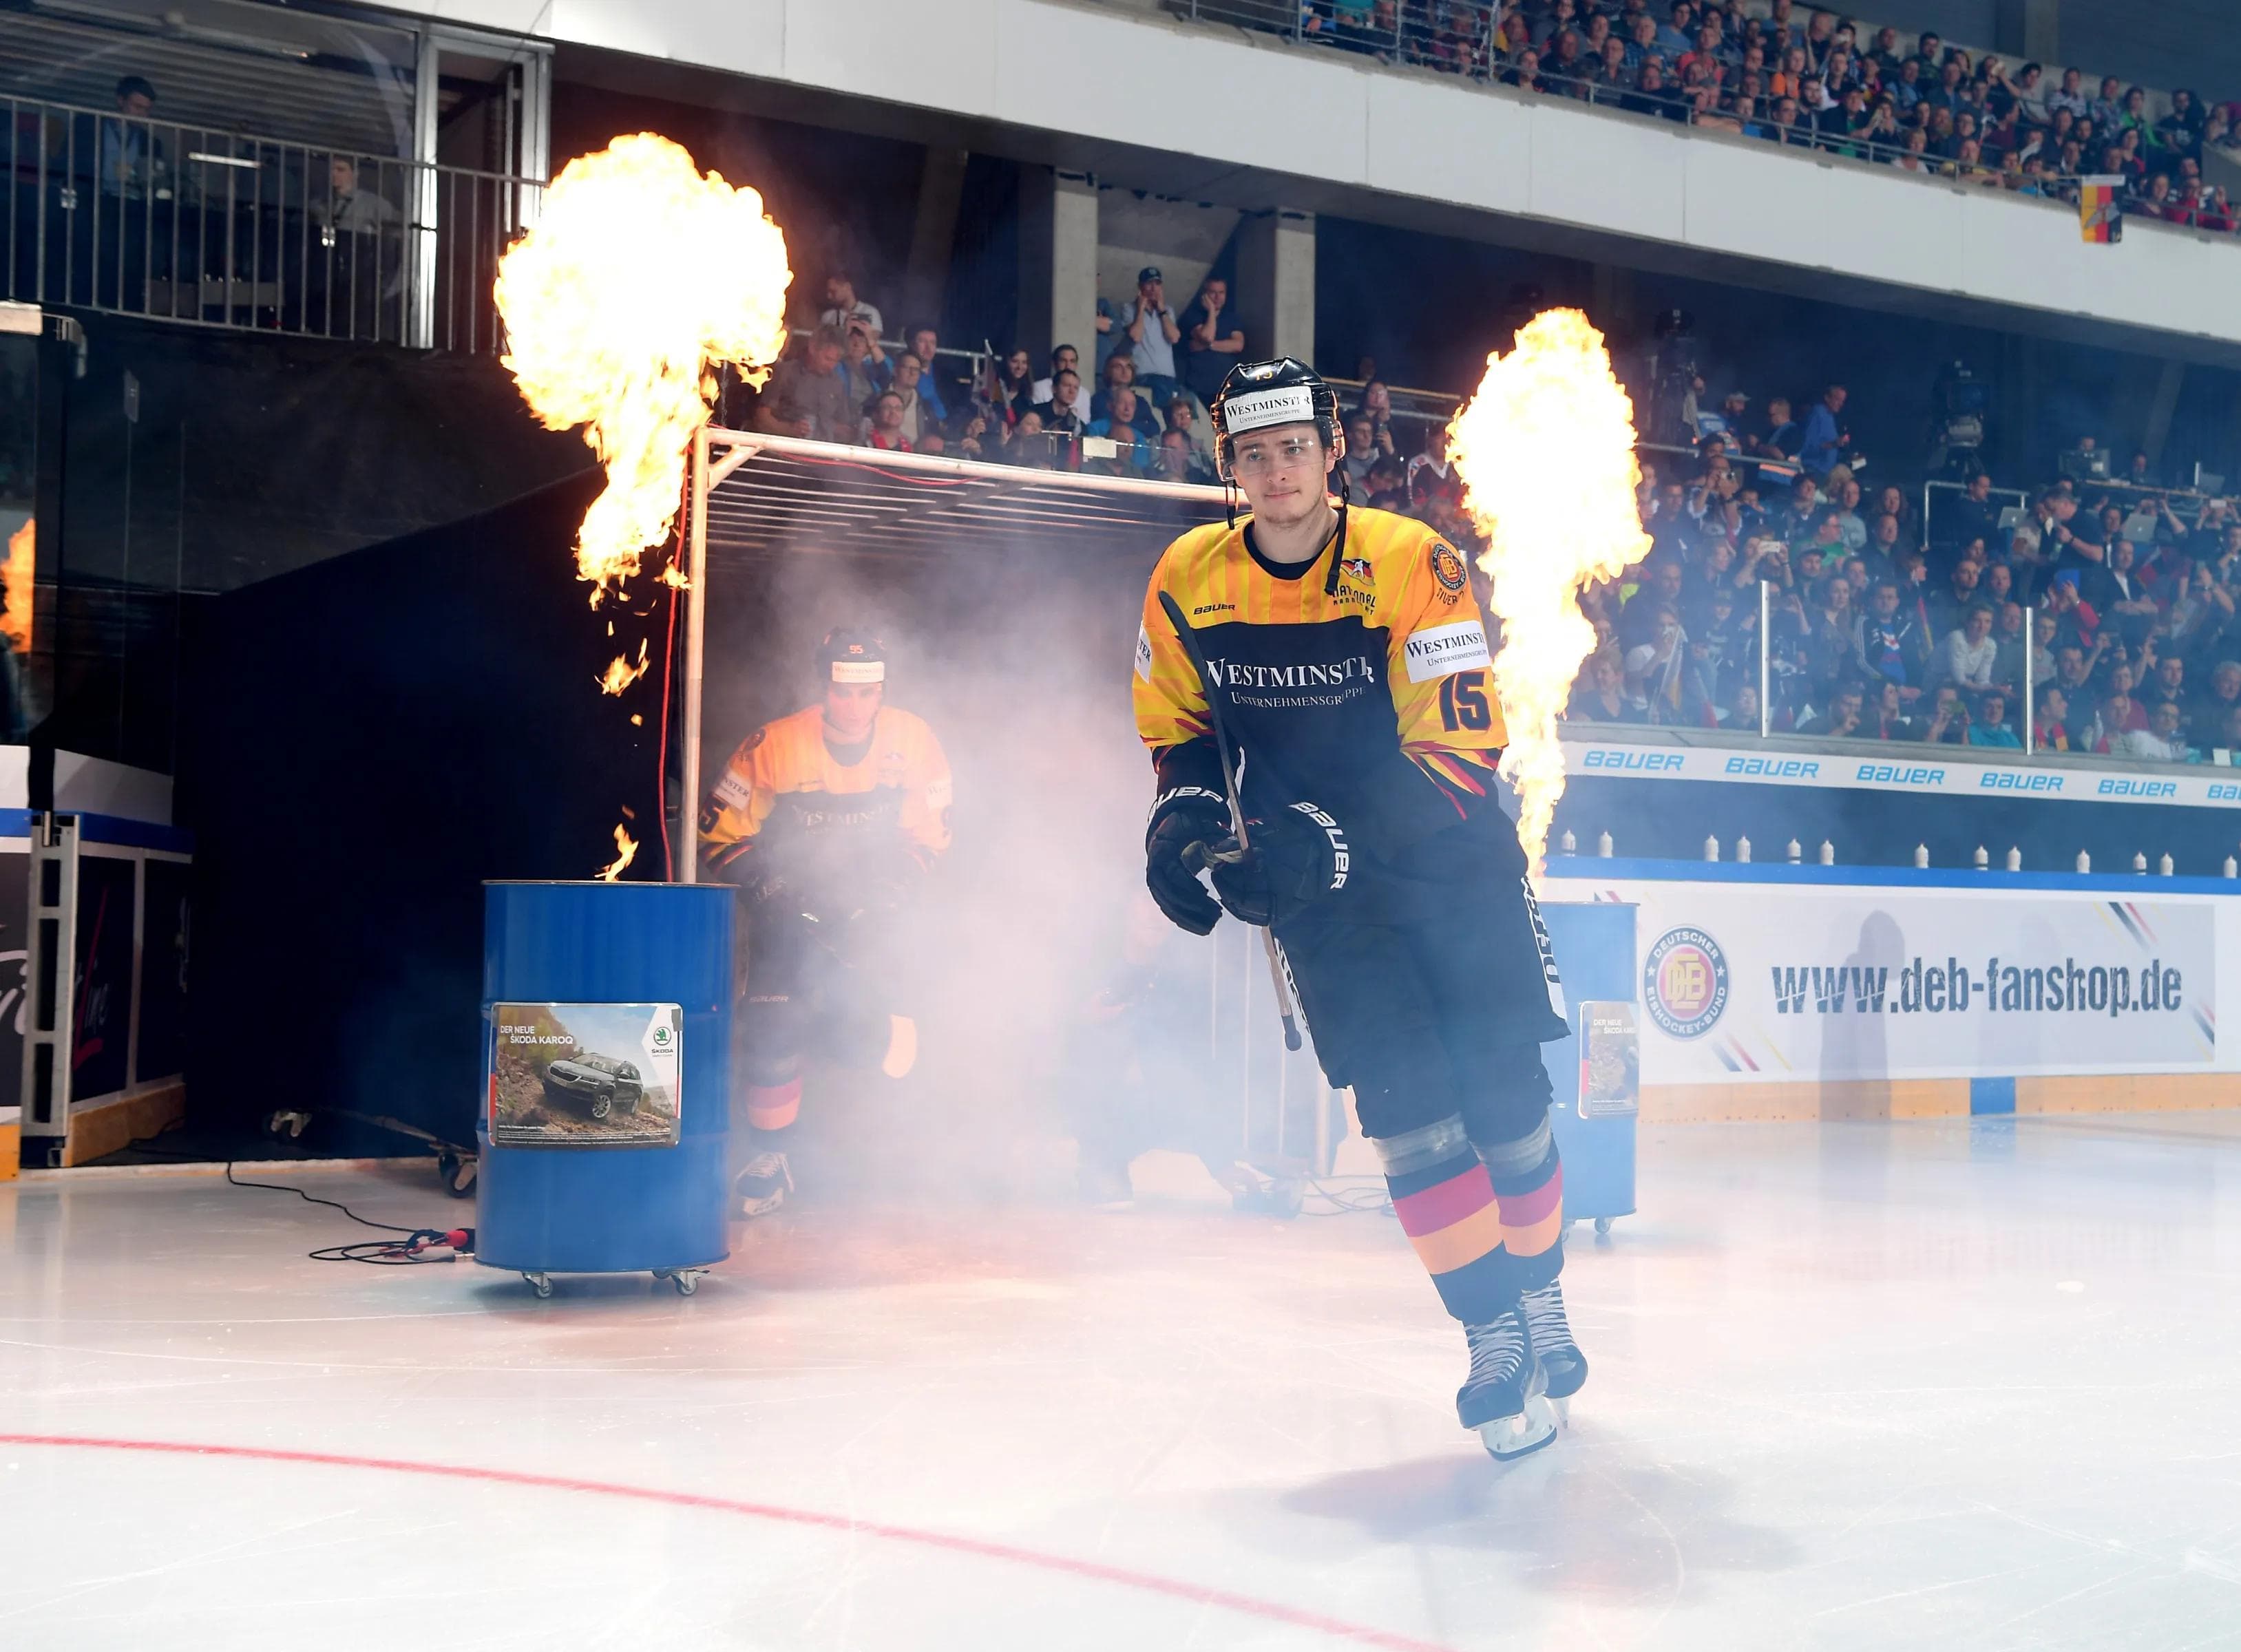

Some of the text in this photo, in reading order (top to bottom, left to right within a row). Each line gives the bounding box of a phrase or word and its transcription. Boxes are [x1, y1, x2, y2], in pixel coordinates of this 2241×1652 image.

[1333, 585, 1376, 608] NATONAL
[849, 644, 864, 654] 95
[1231, 686, 1367, 708] UNTERNEHMENSGRPPE
[1438, 670, 1492, 732] 15
[1584, 750, 1684, 771] BAUER
[1725, 757, 1819, 778] BAUER
[1857, 765, 1945, 785] BAUER
[1980, 772, 2063, 791] BAUER
[2098, 779, 2176, 797] BAUER
[2207, 785, 2241, 800] BA
[1148, 786, 1223, 823] UER
[1287, 801, 1350, 890] BAUER
[1653, 931, 1719, 960] DEUTSCHER
[1771, 957, 2182, 1017] www.deb-fanshop.de
[1646, 986, 1726, 1034] EISHOCKEY-BUND
[501, 1026, 535, 1034] DER NEUE
[510, 1033, 574, 1045] ŠKODA KAROQ
